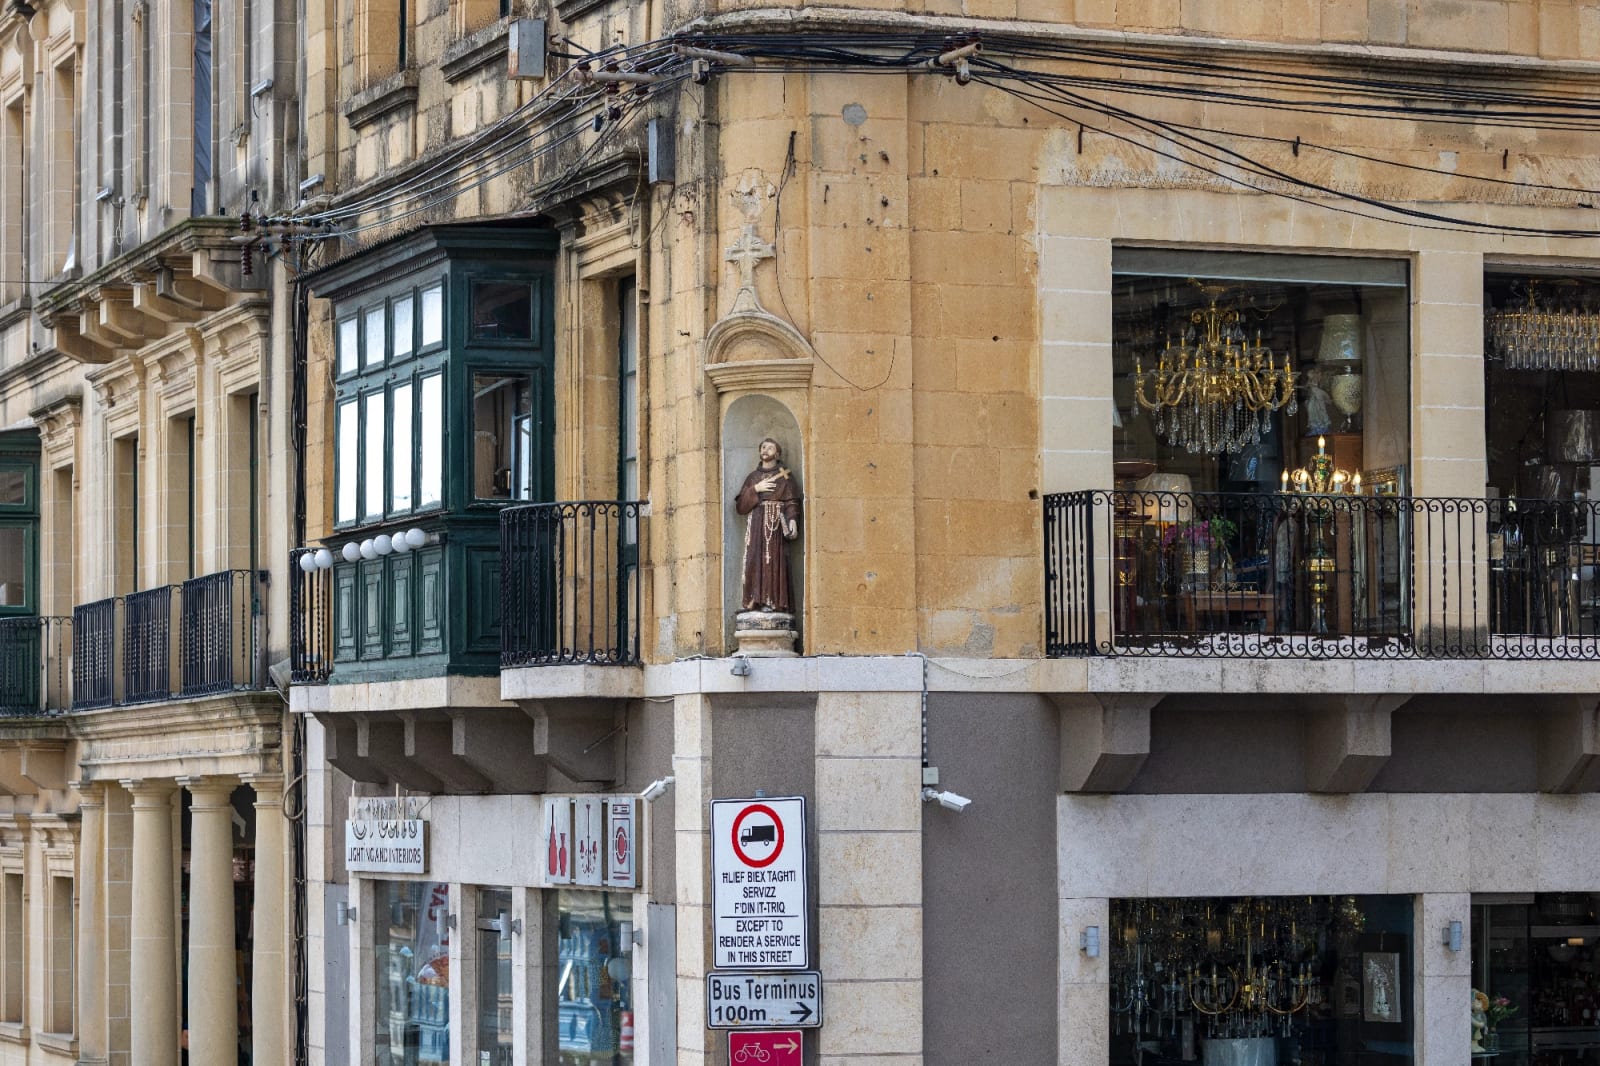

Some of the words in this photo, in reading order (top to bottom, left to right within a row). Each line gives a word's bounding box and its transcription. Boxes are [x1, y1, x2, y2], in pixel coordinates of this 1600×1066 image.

[747, 871, 765, 883] BIEX
[743, 886, 776, 898] SERVIZZ
[734, 902, 755, 914] F'DIN
[757, 901, 785, 914] IT-TRIQ
[736, 920, 769, 932] EXCEPT
[772, 920, 783, 931] TO
[720, 936, 754, 947] RENDER
[756, 936, 762, 947] A
[764, 935, 800, 947] SERVICE
[728, 952, 736, 962] IN
[738, 951, 757, 962] THIS
[760, 951, 792, 962] STREET
[713, 979, 740, 1000] Bus
[745, 978, 815, 1000] Terminus
[715, 1005, 767, 1022] 100m
